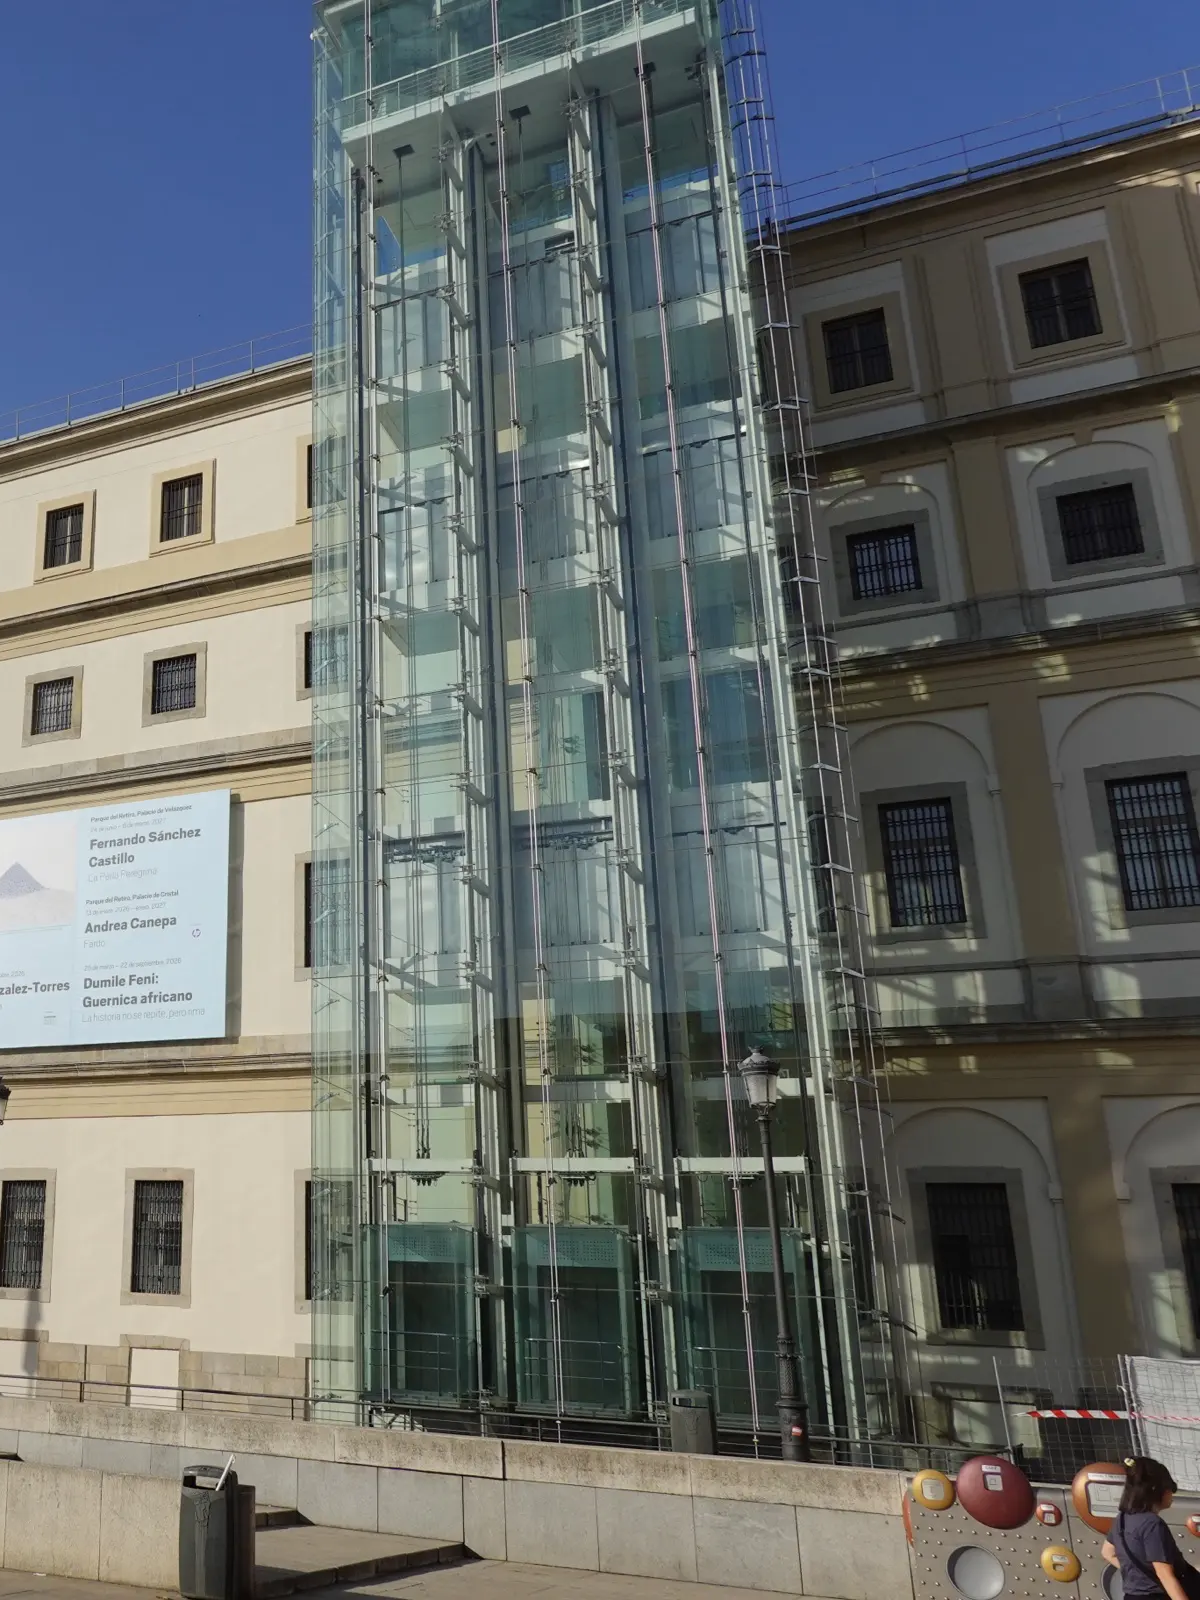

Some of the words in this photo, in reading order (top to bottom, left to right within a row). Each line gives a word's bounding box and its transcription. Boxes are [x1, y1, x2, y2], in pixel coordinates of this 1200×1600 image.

[137, 809, 156, 817] Palacio
[89, 833, 146, 850] Fernando
[148, 828, 201, 843] Sánchez
[88, 852, 135, 868] Castillo
[160, 889, 179, 897] Cristal
[84, 920, 127, 934] Andrea
[130, 916, 177, 930] Canepa
[83, 939, 106, 949] Fardo
[83, 975, 126, 990] Dumile
[128, 972, 159, 986] Feni:
[82, 993, 138, 1008] Guernica
[140, 991, 193, 1005] africano
[81, 1014, 92, 1023] La
[93, 1012, 121, 1022] historia
[122, 1012, 133, 1020] no
[133, 1011, 143, 1020] se
[143, 1009, 168, 1020] repite,
[168, 1008, 187, 1020] pero
[187, 1007, 205, 1016] rima
